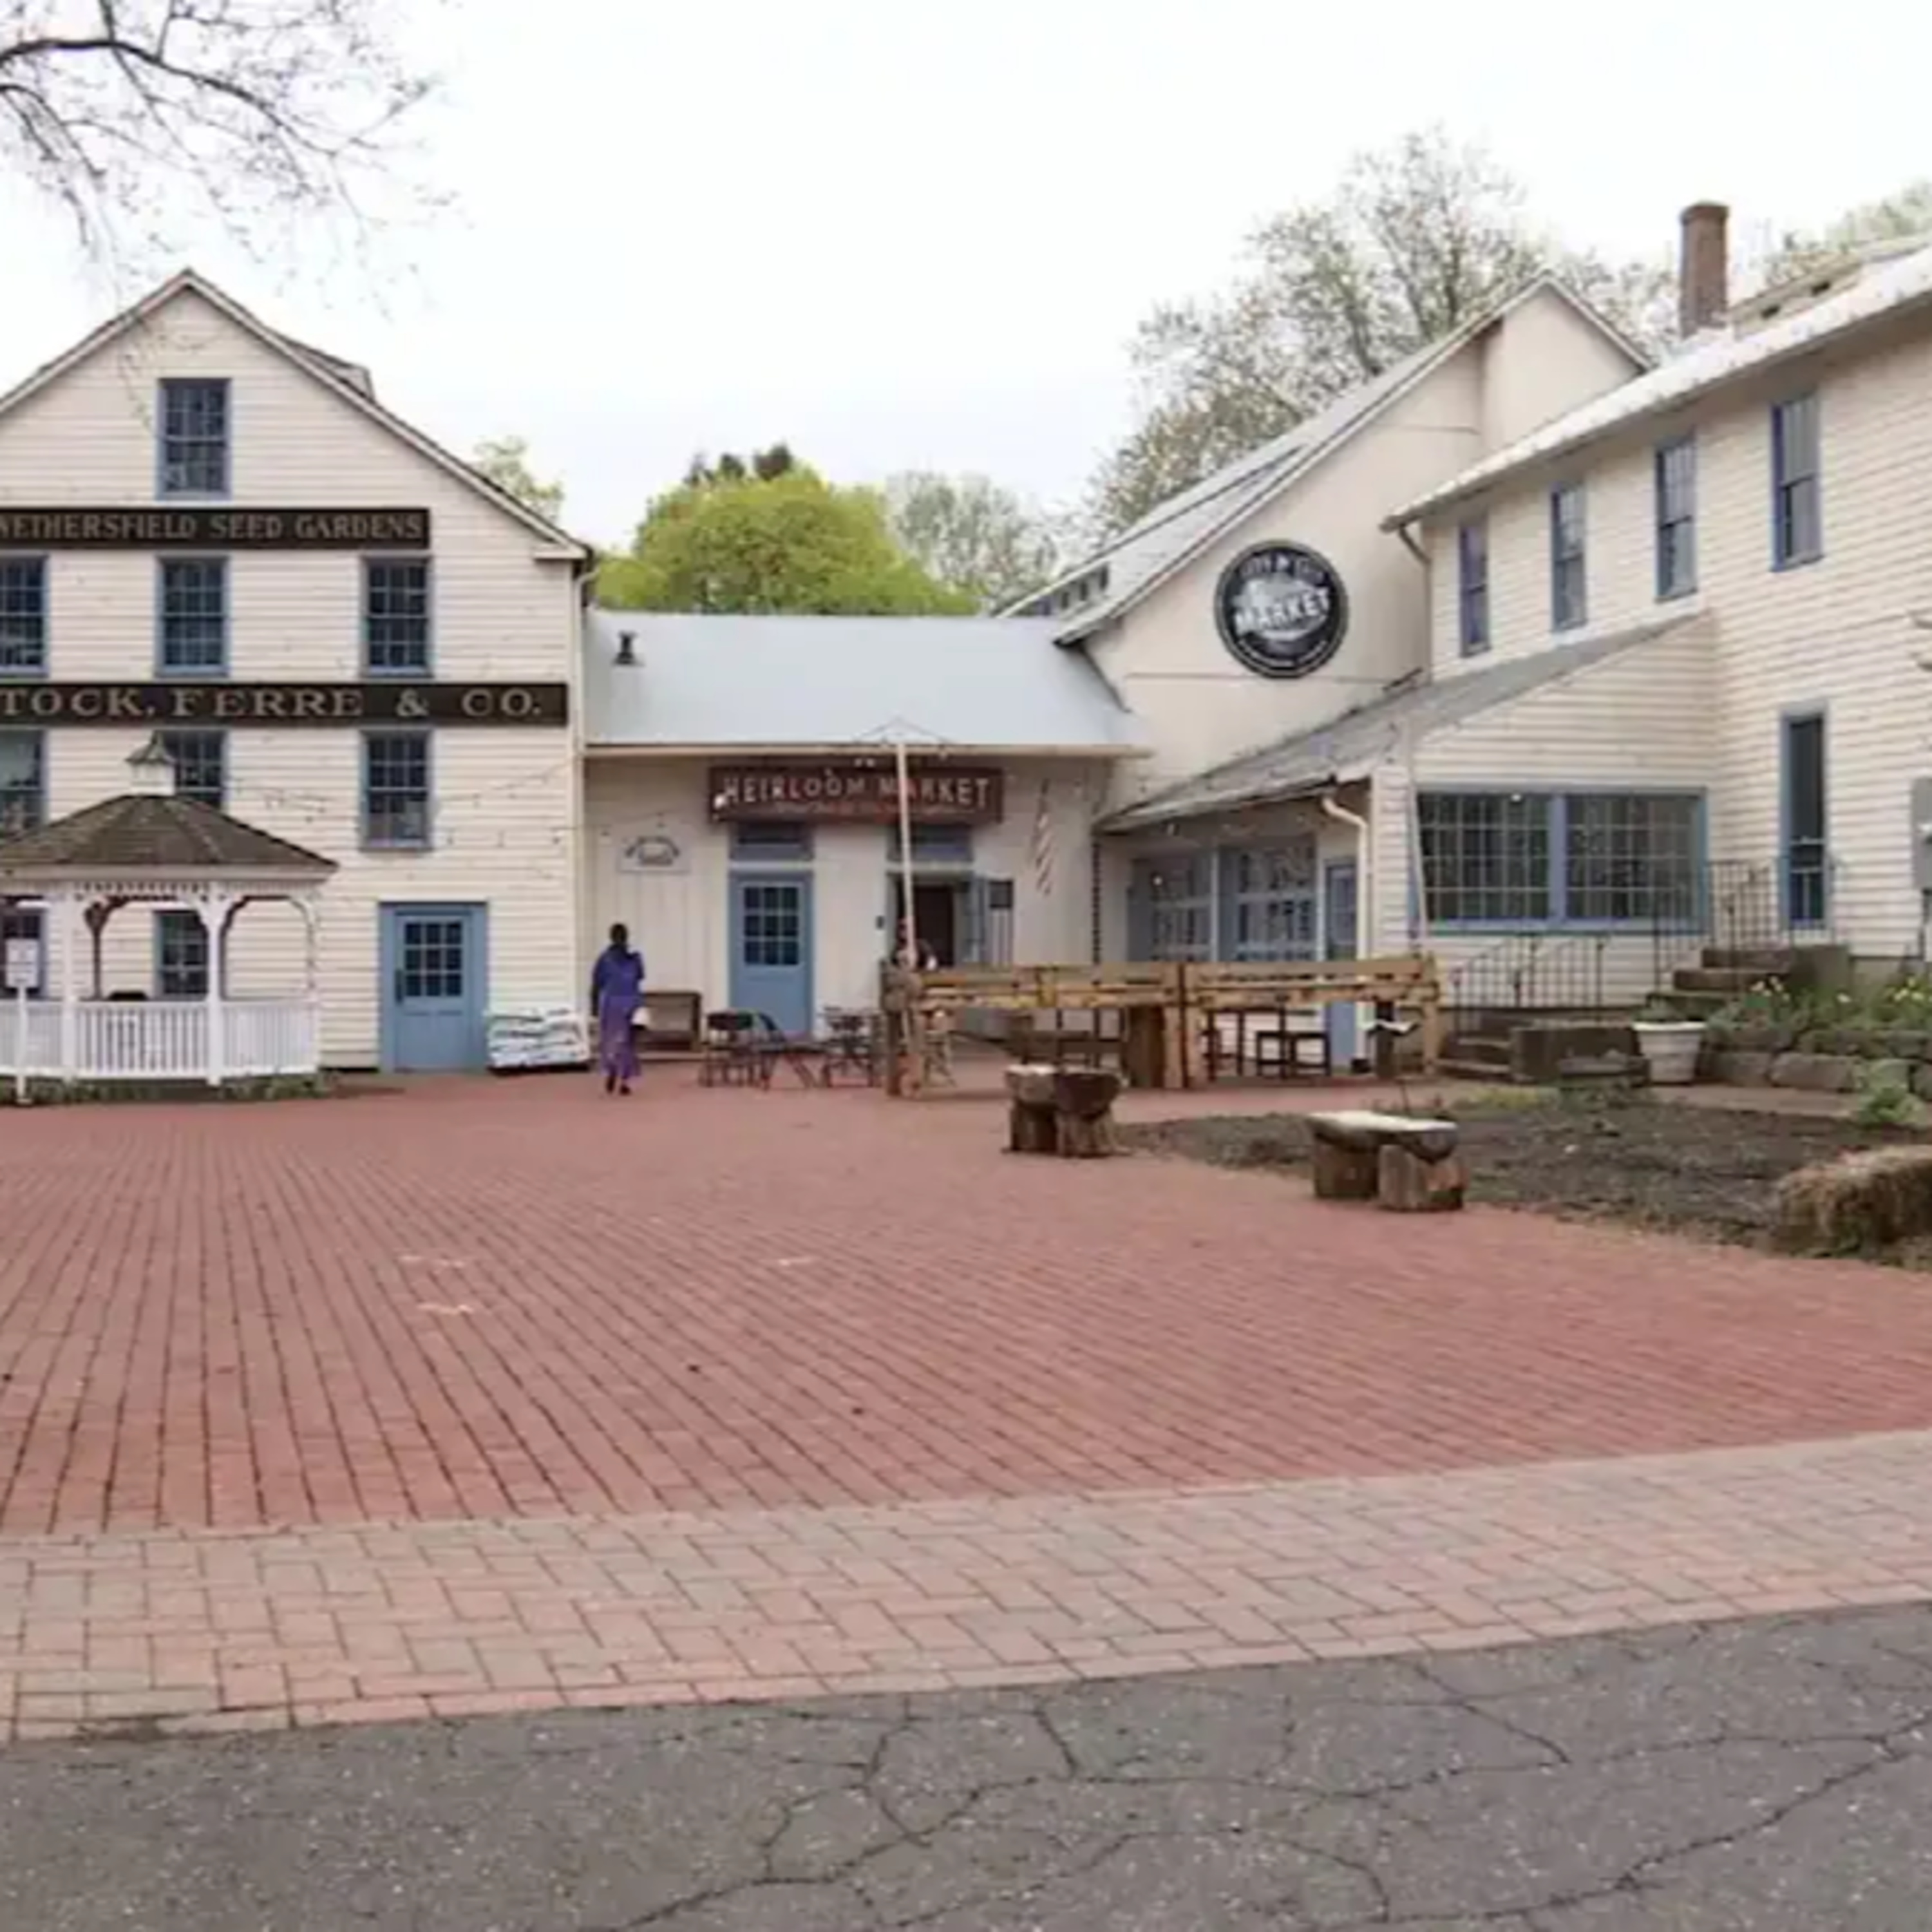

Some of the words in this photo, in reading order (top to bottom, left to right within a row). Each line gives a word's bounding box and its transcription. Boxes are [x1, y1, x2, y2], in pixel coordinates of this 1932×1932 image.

[209, 514, 282, 539] SEED
[295, 514, 422, 539] GARDENS
[169, 688, 363, 717] FERRE
[395, 687, 430, 717] &
[461, 688, 541, 717] CO.
[723, 775, 866, 803] HEIRLOOM
